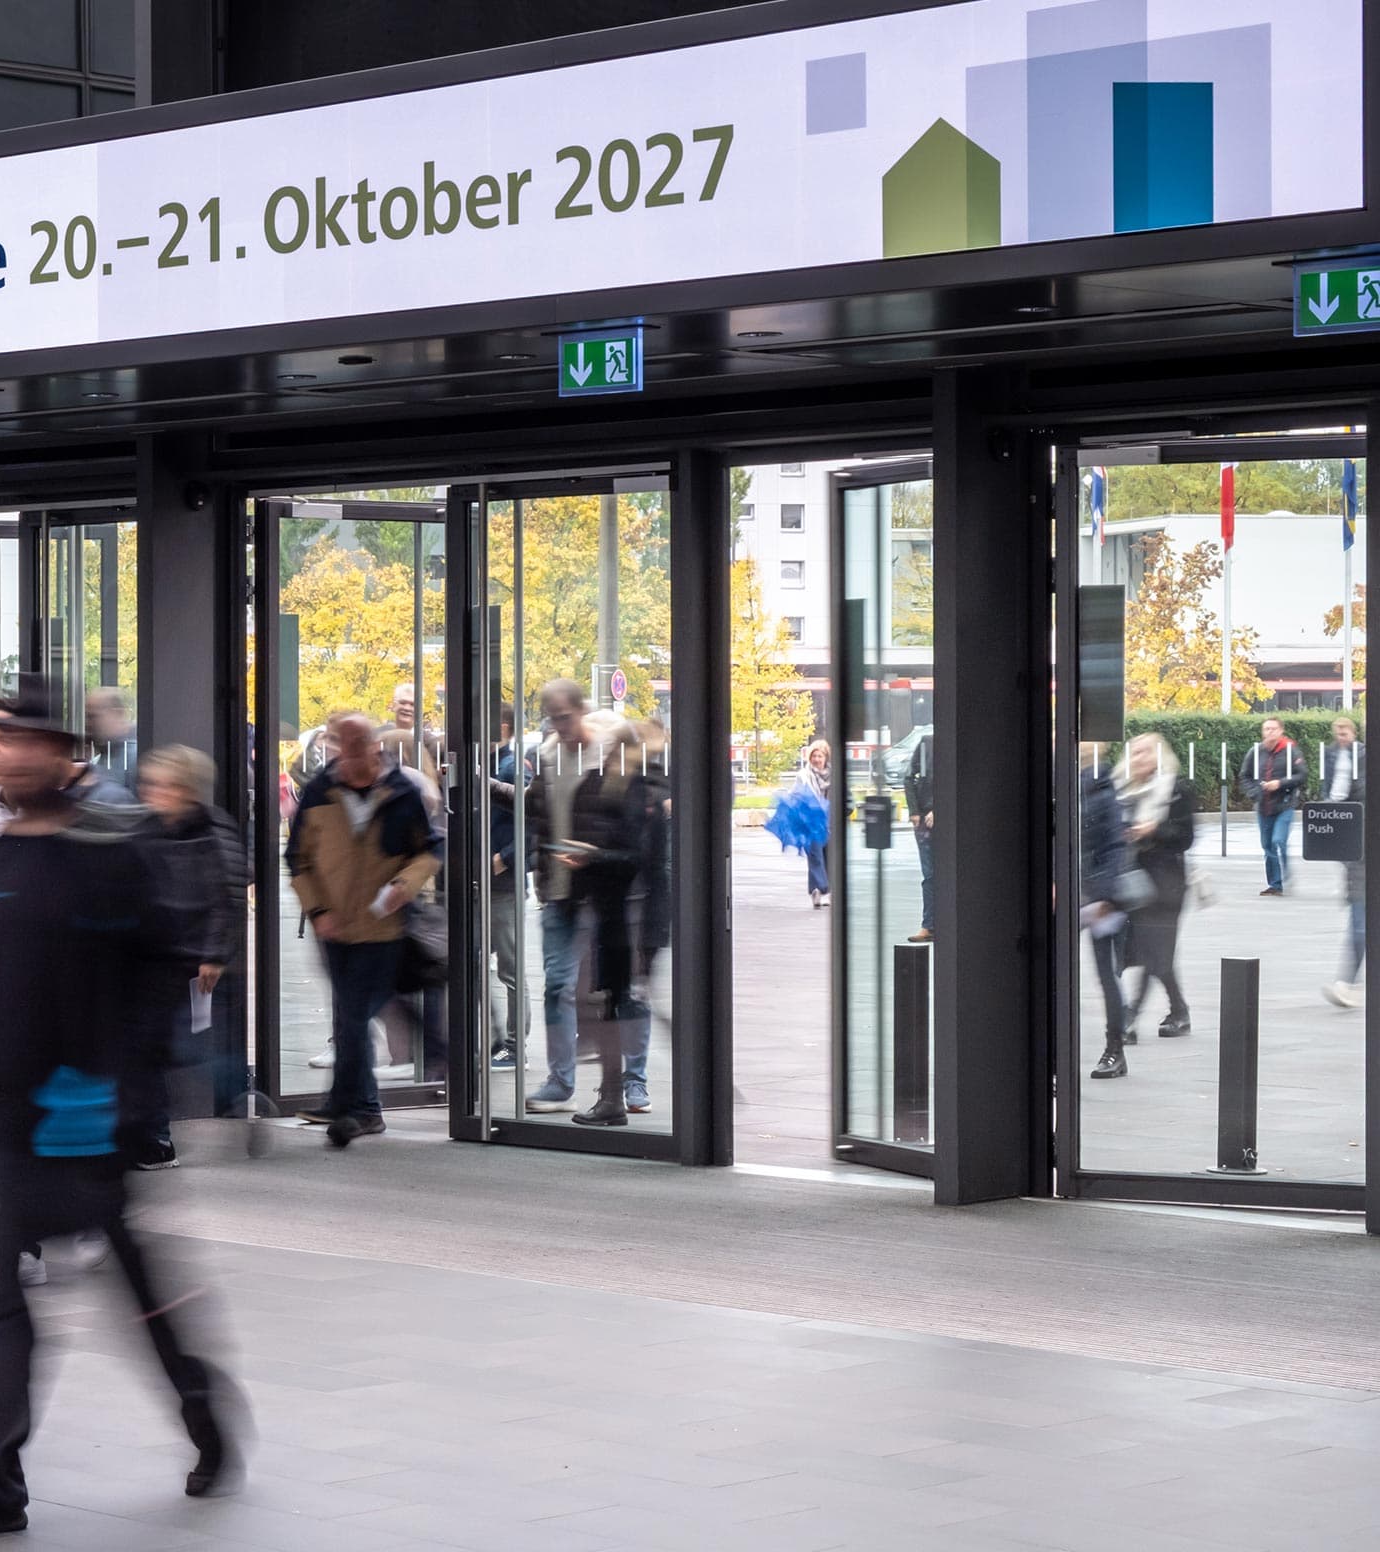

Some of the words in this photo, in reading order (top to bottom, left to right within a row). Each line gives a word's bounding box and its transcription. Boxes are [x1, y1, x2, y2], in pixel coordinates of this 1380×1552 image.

[263, 161, 533, 255] Oktober
[554, 124, 735, 220] 2027
[1308, 809, 1353, 819] Drücken
[1308, 823, 1334, 833] Push
